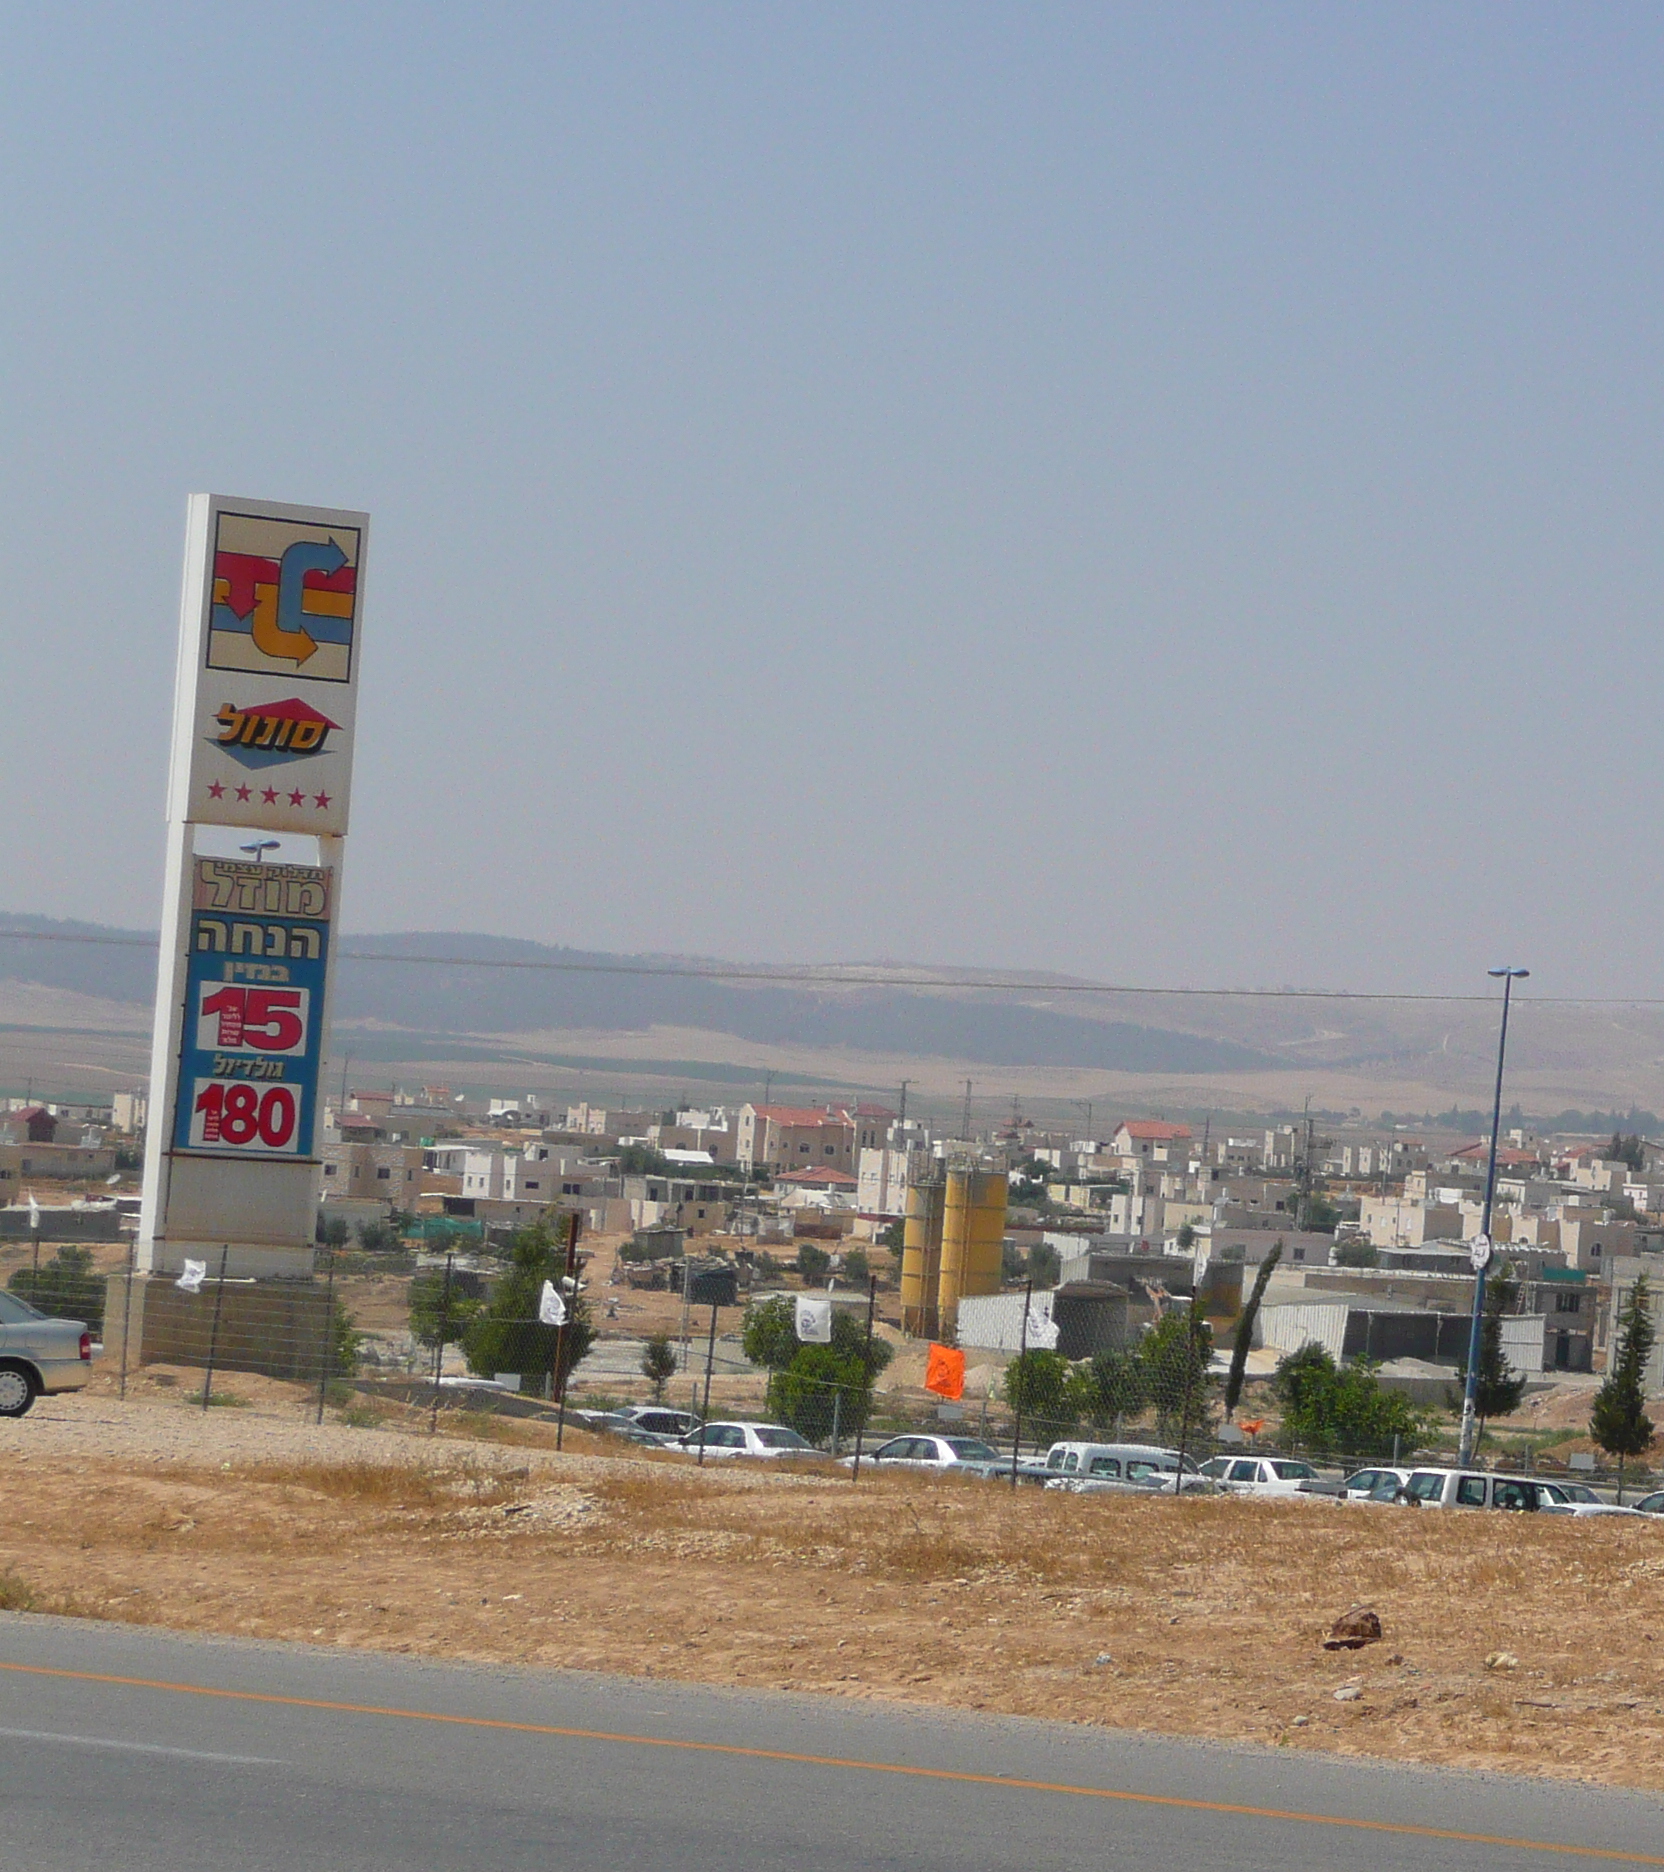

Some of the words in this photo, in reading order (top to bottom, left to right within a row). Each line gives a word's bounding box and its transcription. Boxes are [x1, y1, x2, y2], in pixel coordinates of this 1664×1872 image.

[217, 703, 329, 754] סונול
[200, 860, 326, 916] מוזל
[197, 919, 320, 959] הנחה
[202, 986, 303, 1050] 15
[195, 1082, 296, 1147] 180
